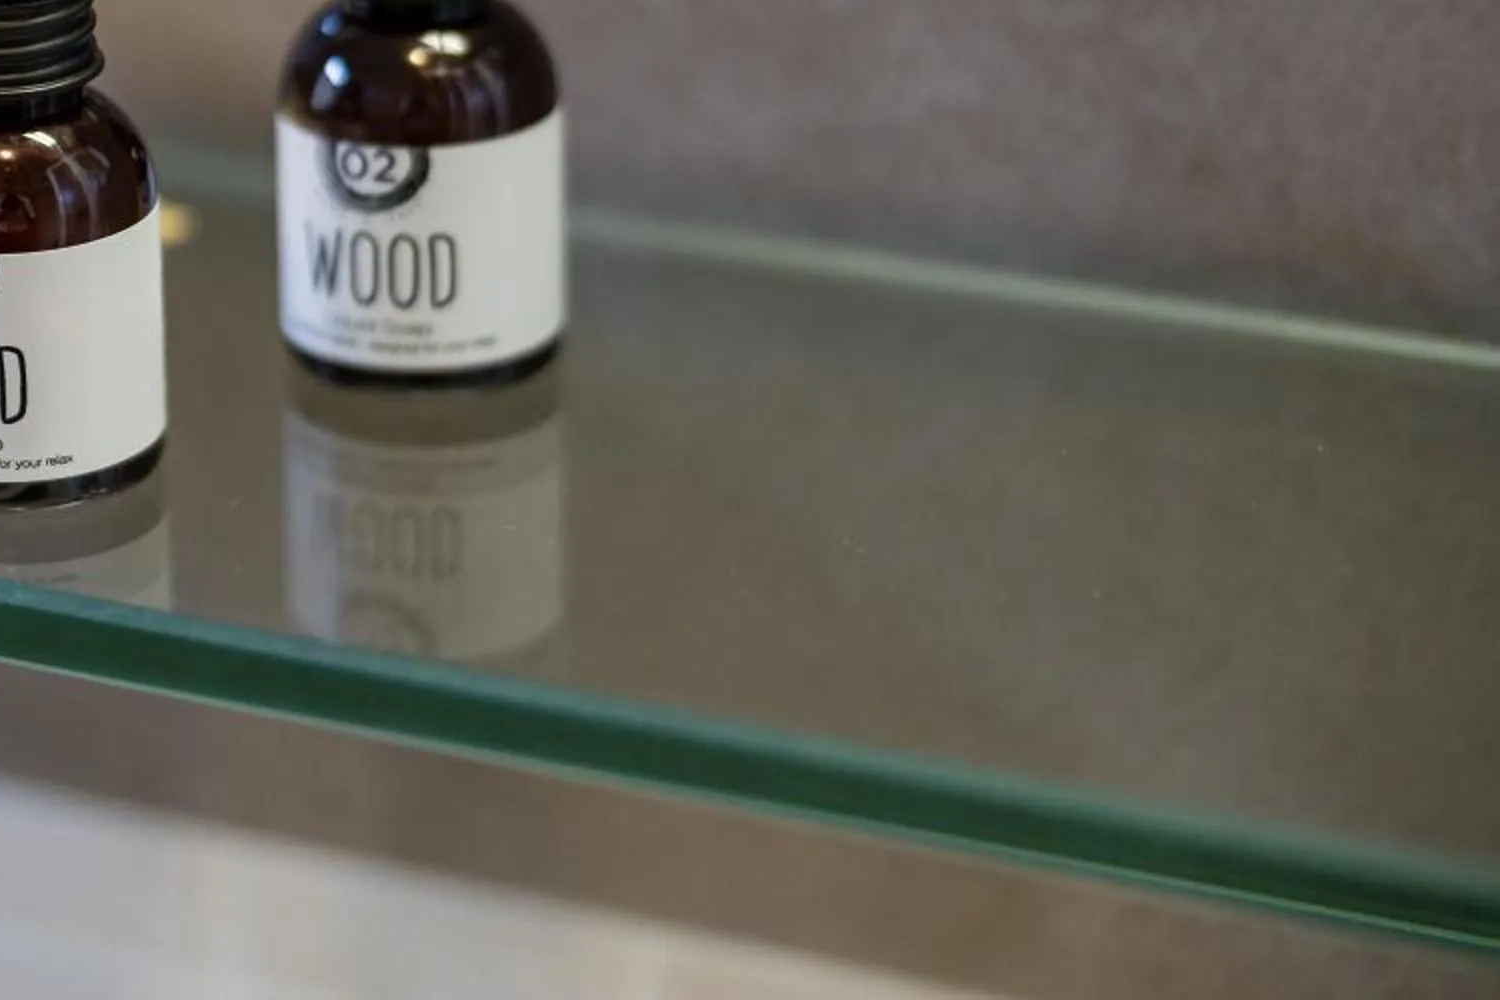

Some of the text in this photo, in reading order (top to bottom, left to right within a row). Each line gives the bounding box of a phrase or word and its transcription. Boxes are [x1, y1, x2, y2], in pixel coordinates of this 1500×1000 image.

[304, 219, 458, 311] WOOD
[14, 456, 42, 471] your
[45, 453, 74, 467] relax
